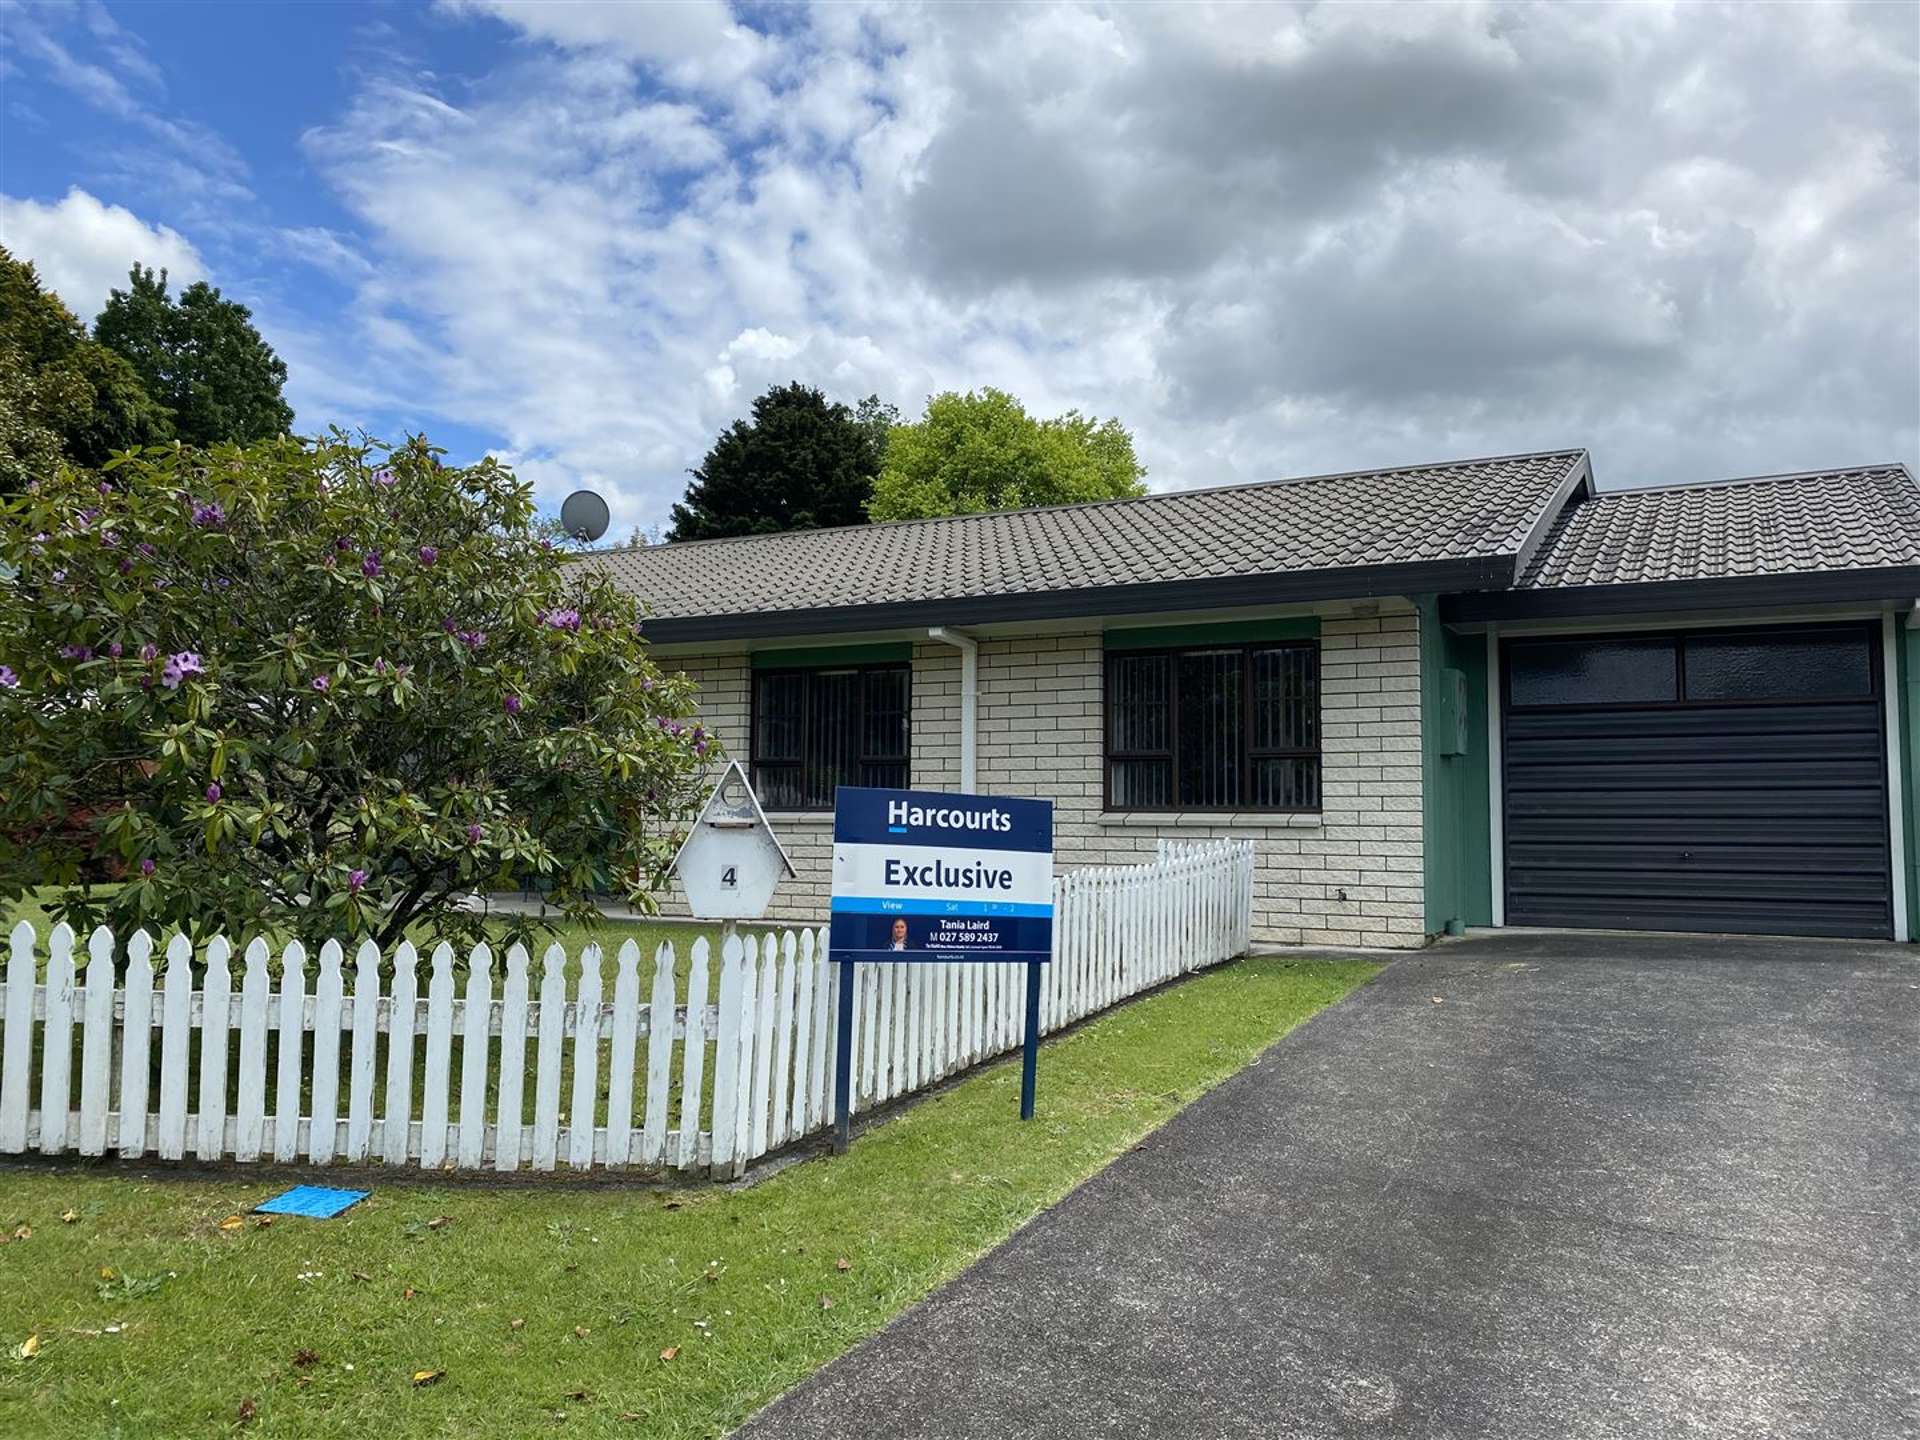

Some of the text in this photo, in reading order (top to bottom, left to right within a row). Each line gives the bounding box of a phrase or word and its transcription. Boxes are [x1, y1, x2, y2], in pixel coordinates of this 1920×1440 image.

[888, 800, 1012, 832] Harcourts
[721, 867, 736, 886] 4
[884, 859, 1013, 890] Exclusive
[881, 901, 904, 911] View
[940, 919, 991, 930] Tania Laird
[939, 931, 957, 942] 027
[959, 932, 976, 942] 589
[977, 932, 999, 942] 2437
